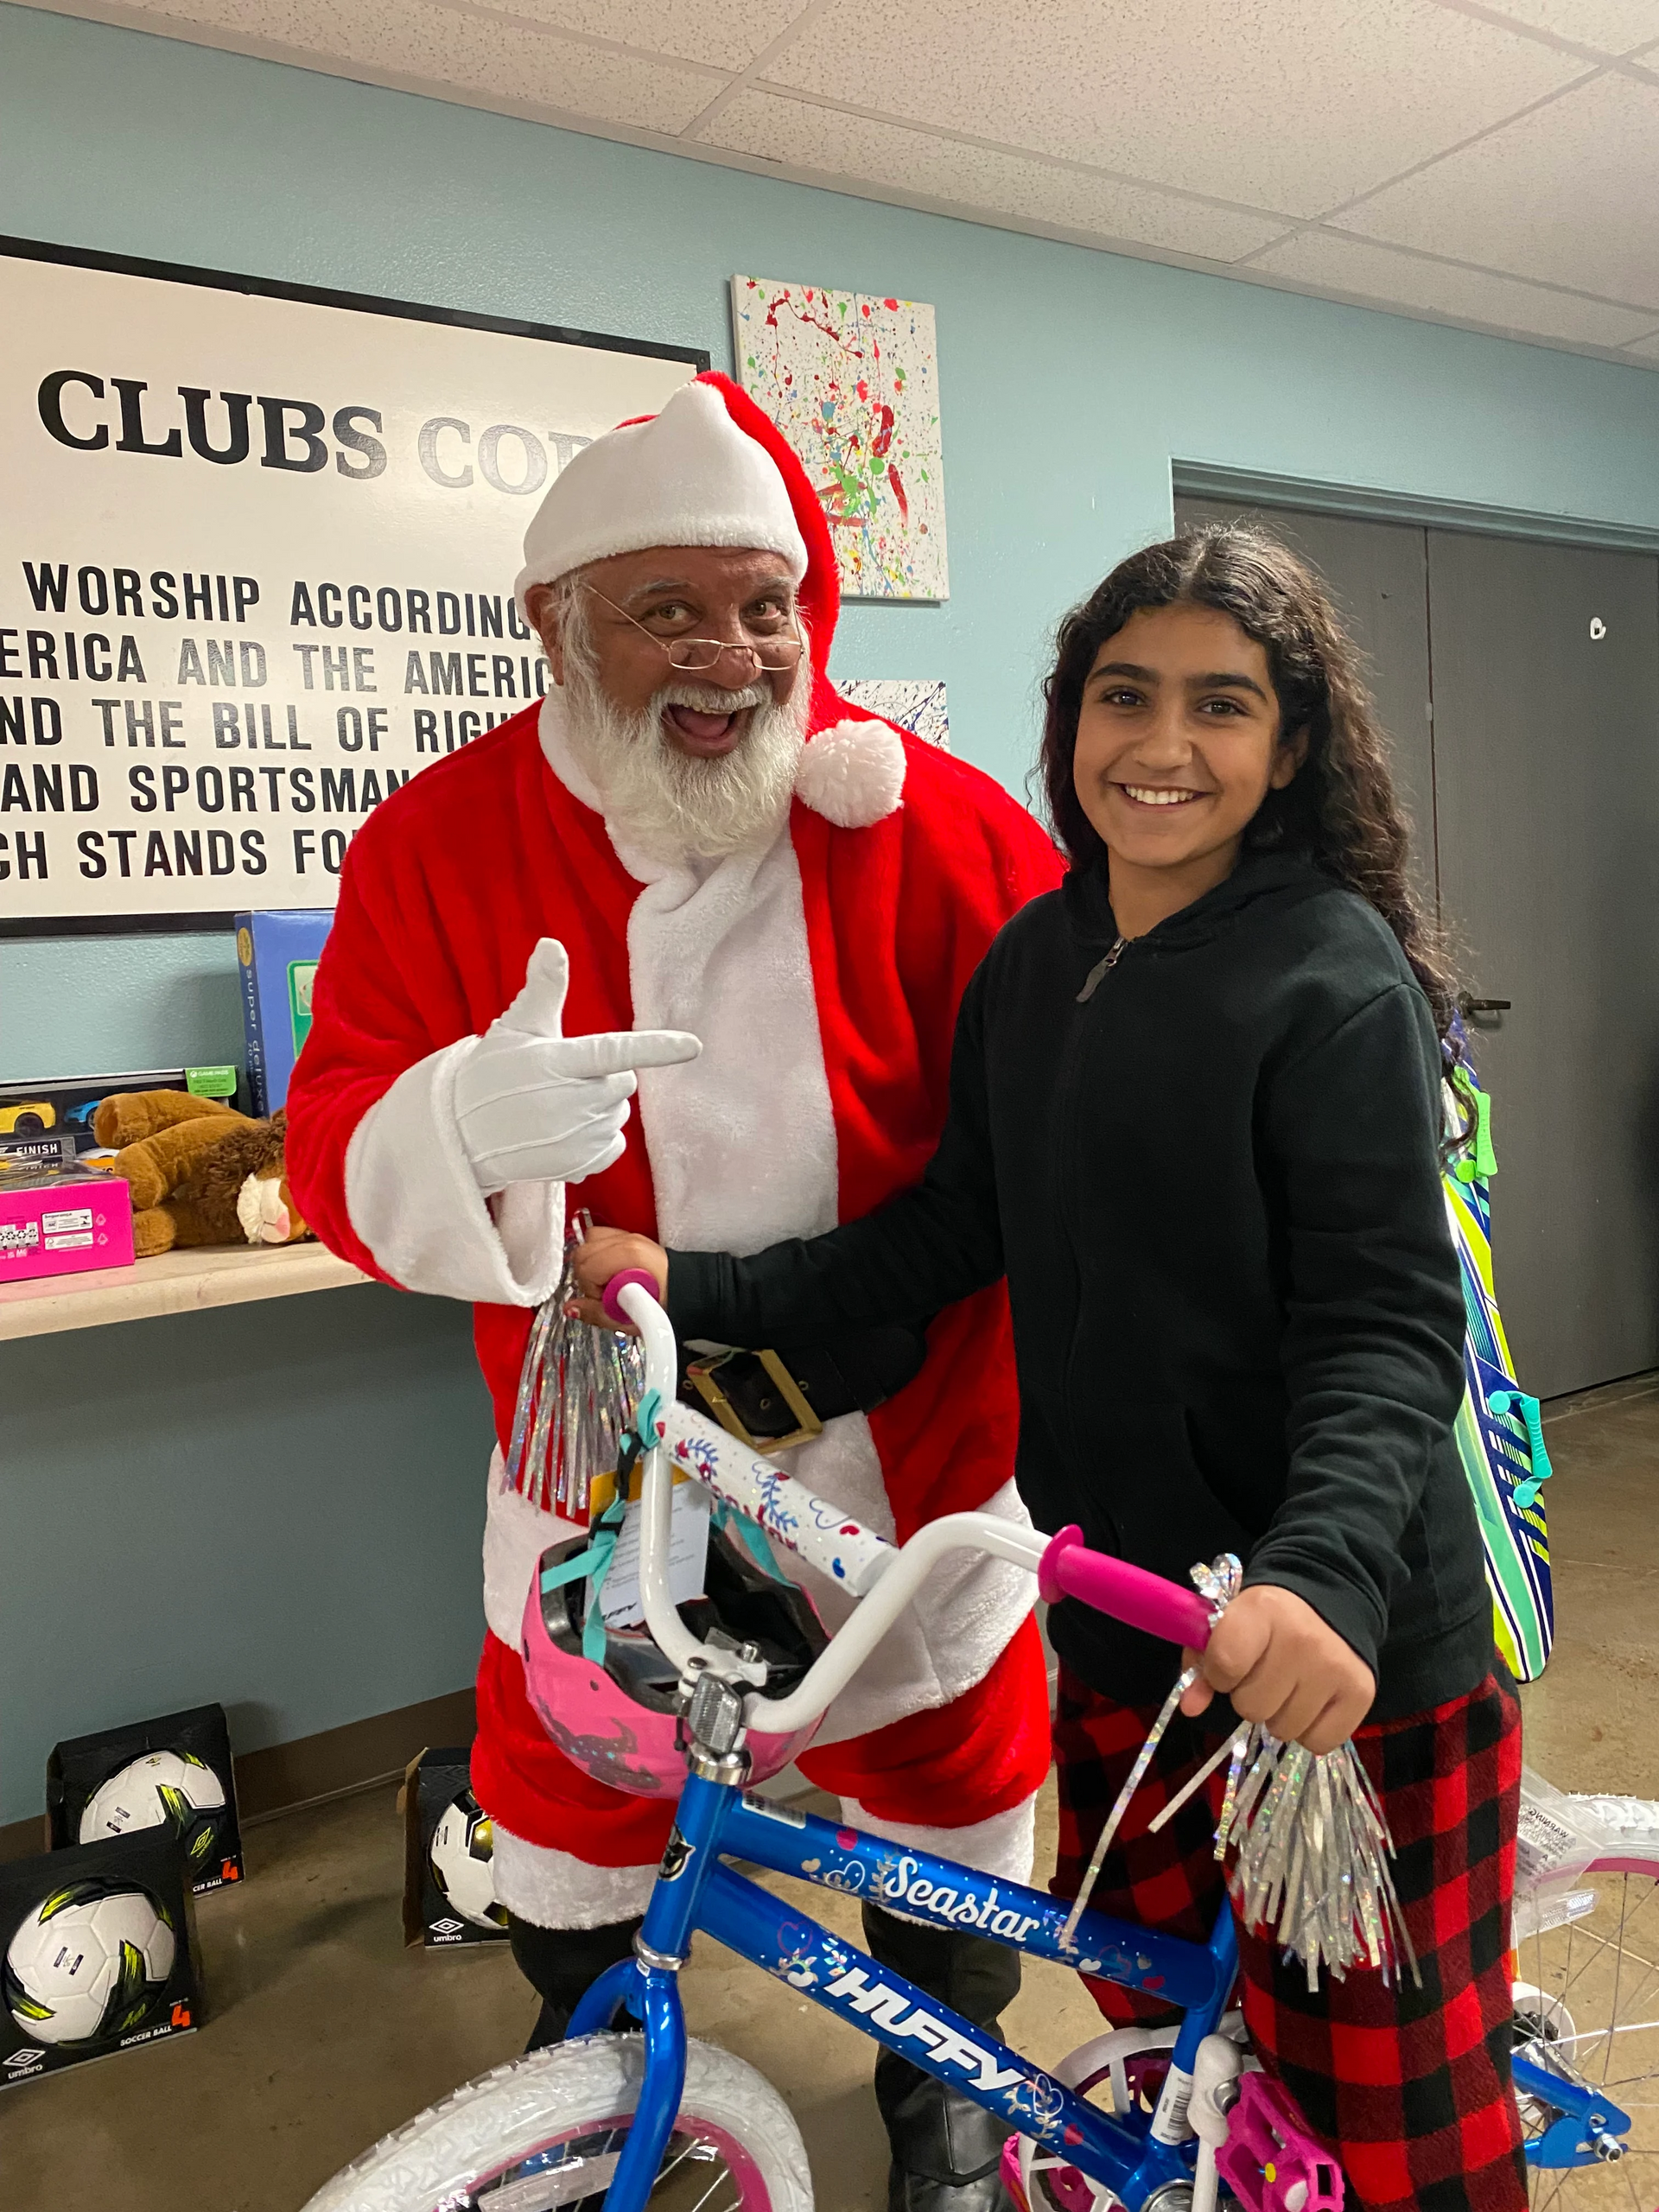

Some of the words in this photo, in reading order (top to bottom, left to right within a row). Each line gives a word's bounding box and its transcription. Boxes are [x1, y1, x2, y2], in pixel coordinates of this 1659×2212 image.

[37, 369, 388, 480] CLUBS
[22, 561, 261, 622] WORSHIP
[290, 581, 531, 640] ACCORDING
[0, 628, 147, 683] ERICA
[177, 638, 267, 688] AND
[293, 643, 378, 692] THE
[404, 651, 552, 698] AMERIC
[0, 696, 62, 747] ND
[92, 698, 185, 748] THE
[212, 702, 313, 751] BILL
[337, 706, 389, 752] OF
[413, 709, 518, 753] RIG
[1, 763, 99, 812] AND
[78, 829, 267, 880] STANDS
[293, 829, 360, 874] FO
[245, 969, 257, 1031] super
[252, 1039, 264, 1112] deluxe
[16, 1143, 58, 1154] FINISH
[207, 1878, 223, 1888] BALL
[222, 1860, 238, 1880] 4
[884, 1855, 1039, 1942] Seastar
[433, 1934, 462, 1942] umbro
[120, 2031, 151, 2046] SOCCER
[153, 2024, 172, 2037] BALL
[171, 2004, 191, 2027] 4
[823, 1967, 1027, 2091] HUFFY
[8, 2063, 43, 2079] umbro
